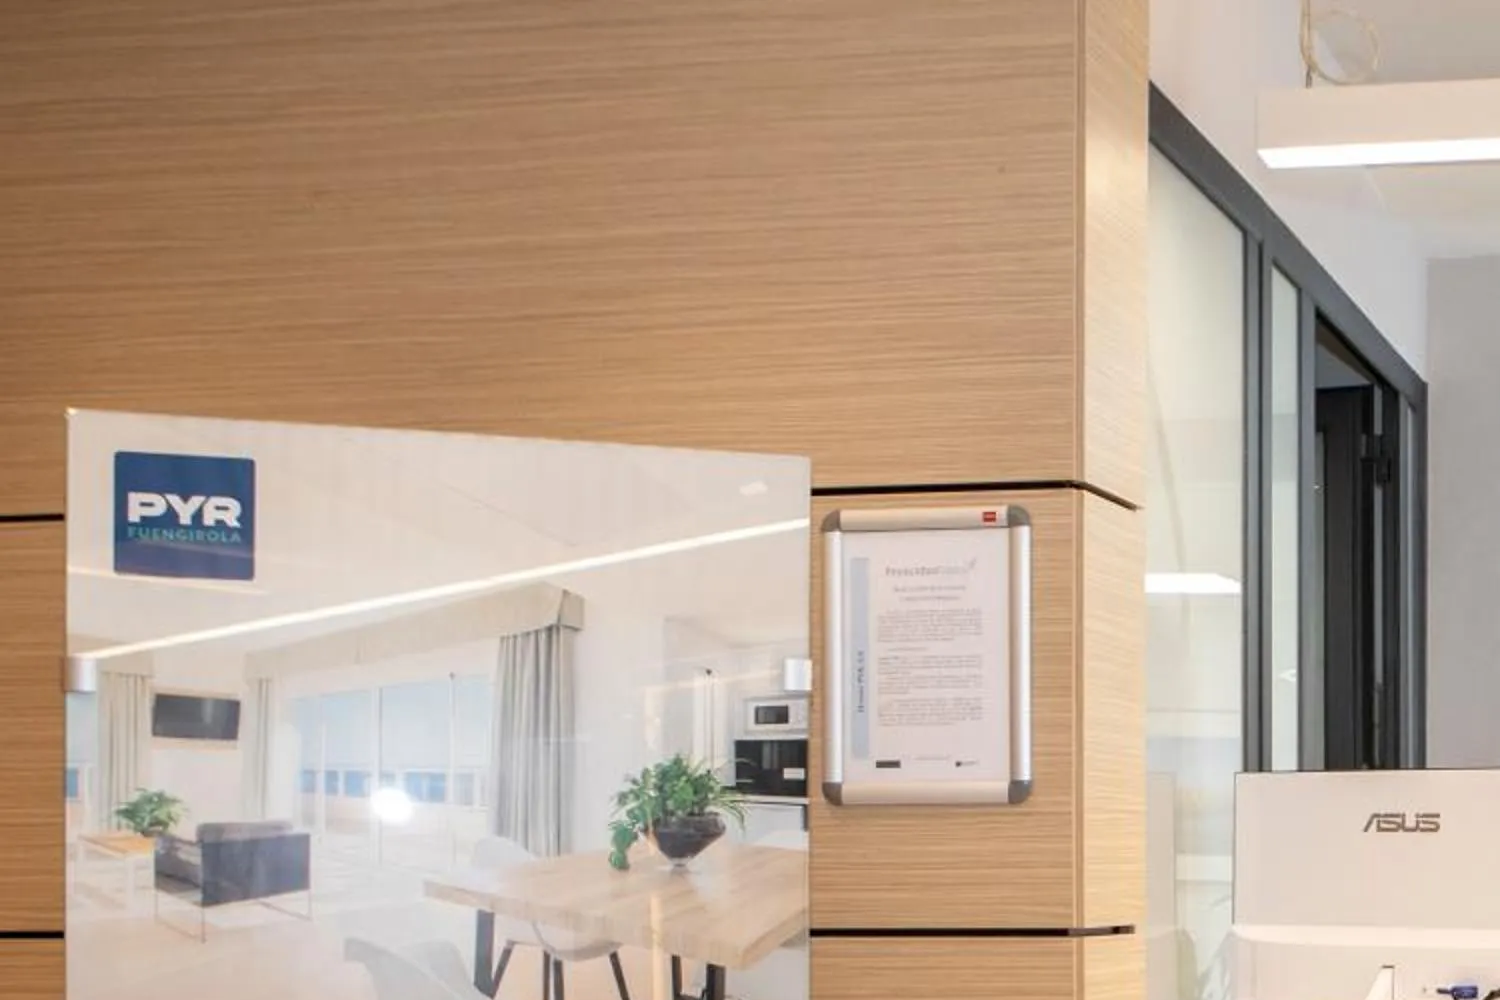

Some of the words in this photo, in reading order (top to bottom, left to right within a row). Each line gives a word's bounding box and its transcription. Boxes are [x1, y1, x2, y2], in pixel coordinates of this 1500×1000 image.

[127, 491, 242, 528] PYR
[127, 526, 241, 543] FUENGIROLA
[1363, 813, 1440, 833] ASUS
